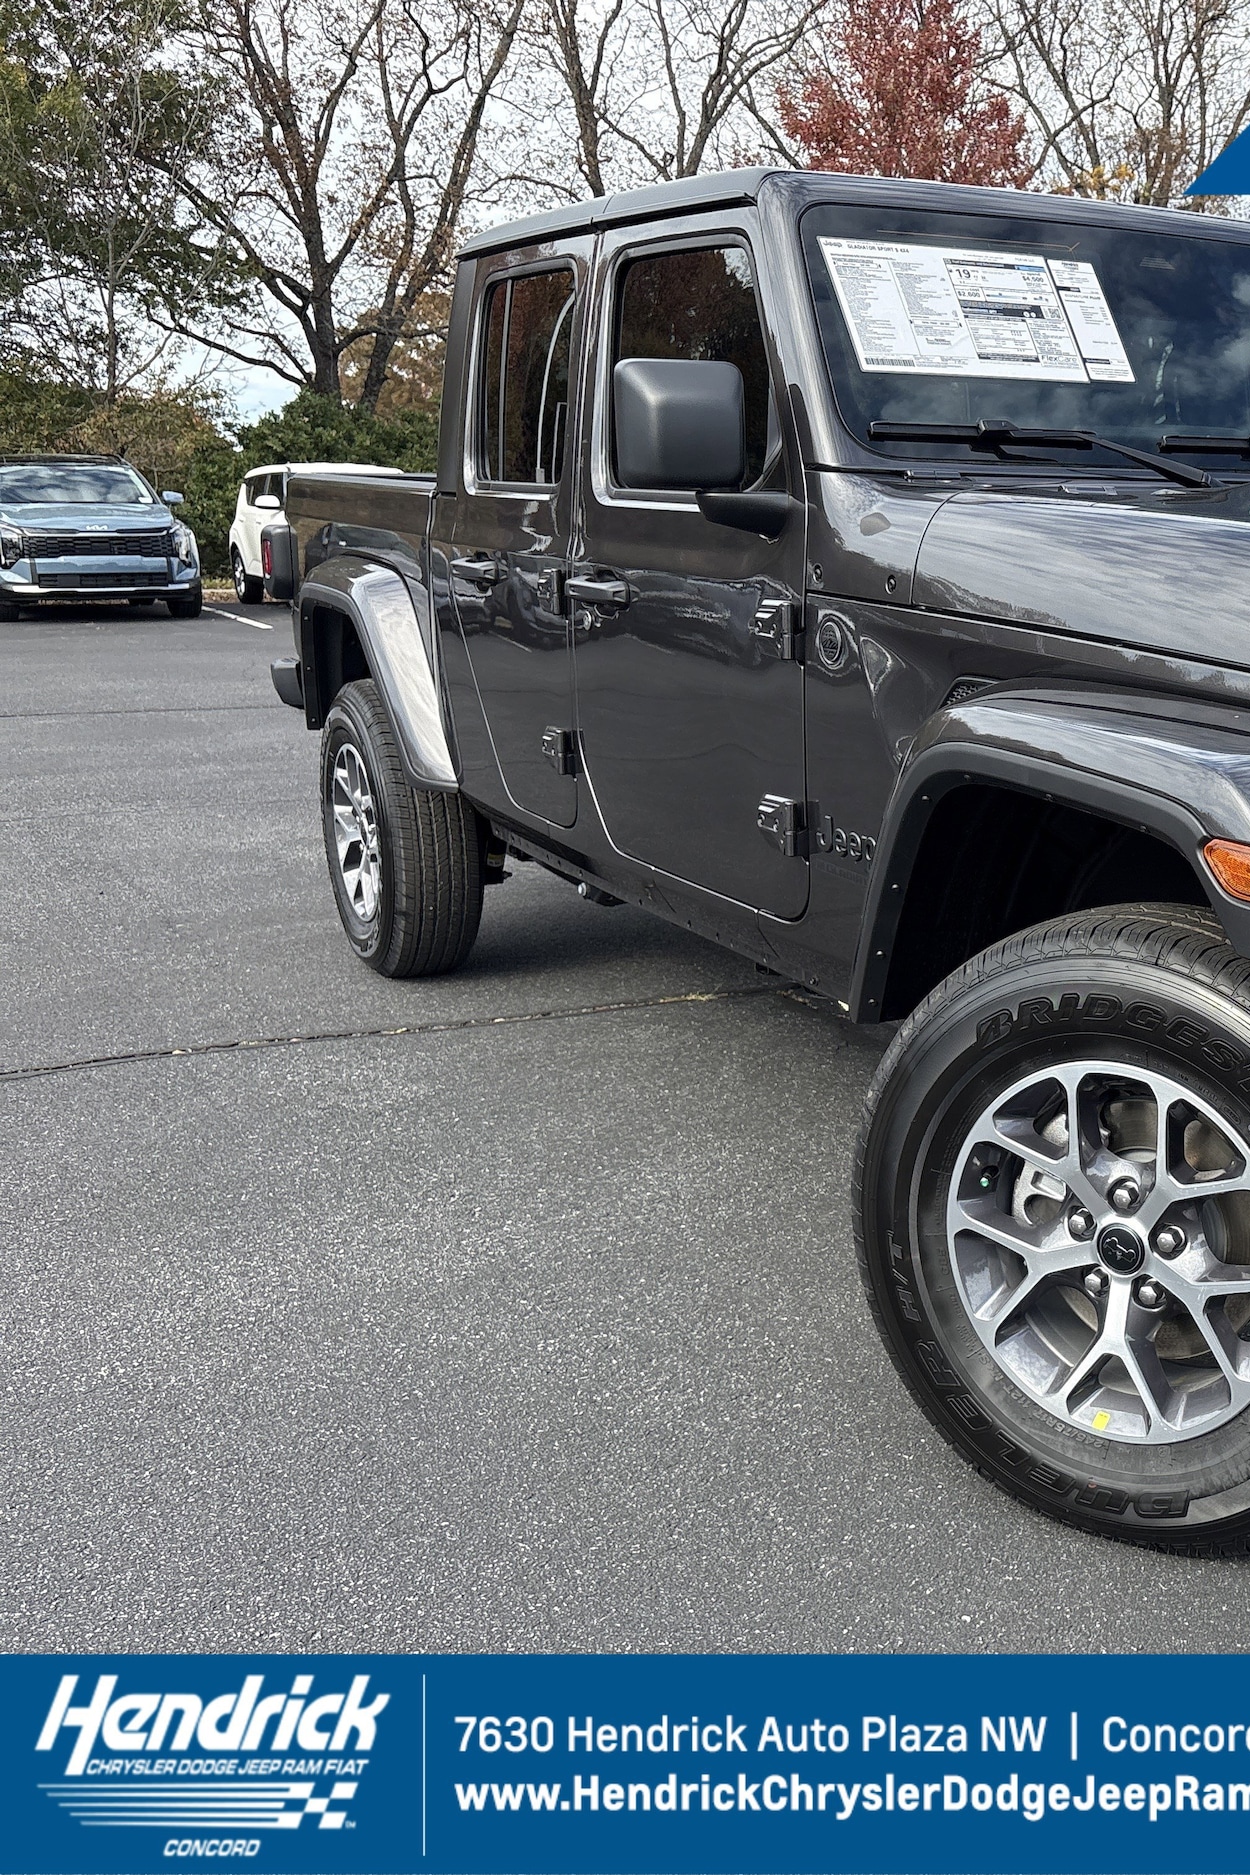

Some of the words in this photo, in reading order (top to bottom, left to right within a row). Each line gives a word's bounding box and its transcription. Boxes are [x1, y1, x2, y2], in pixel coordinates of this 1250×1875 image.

[955, 268, 971, 279] 19
[816, 814, 877, 871] Jeep
[917, 1340, 1190, 1518] DUELER
